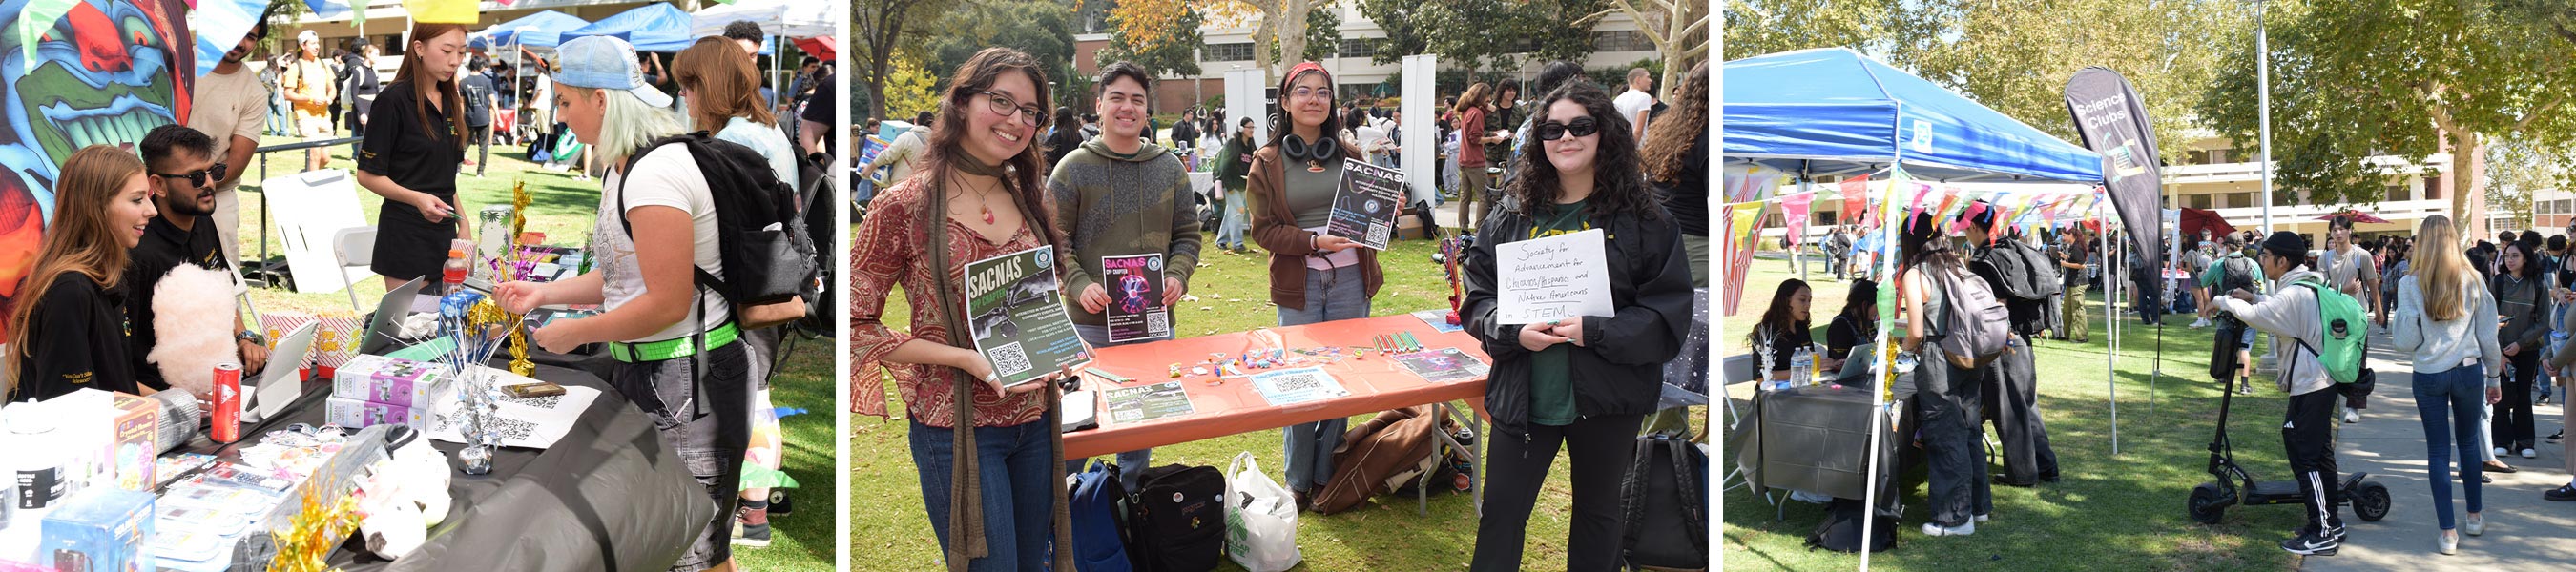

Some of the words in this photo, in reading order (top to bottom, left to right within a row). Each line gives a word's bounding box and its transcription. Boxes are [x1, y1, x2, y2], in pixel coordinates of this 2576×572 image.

[2075, 92, 2126, 116] Science
[2088, 110, 2126, 130] Clubs
[1344, 162, 1403, 183] SACNAS
[1517, 242, 1555, 261] Society
[1559, 242, 1569, 253] for
[1105, 257, 1146, 269] SACNAS
[1515, 260, 1571, 273] Advancement
[968, 255, 1023, 299] SACNAS
[1574, 271, 1589, 279] and
[970, 299, 982, 313] CPP
[982, 288, 1007, 306] CHAPTER
[1518, 291, 1546, 303] Native
[1523, 305, 1567, 319] STEM
[1107, 385, 1153, 399] SACNAS
[1228, 540, 1251, 553] OLLAR
